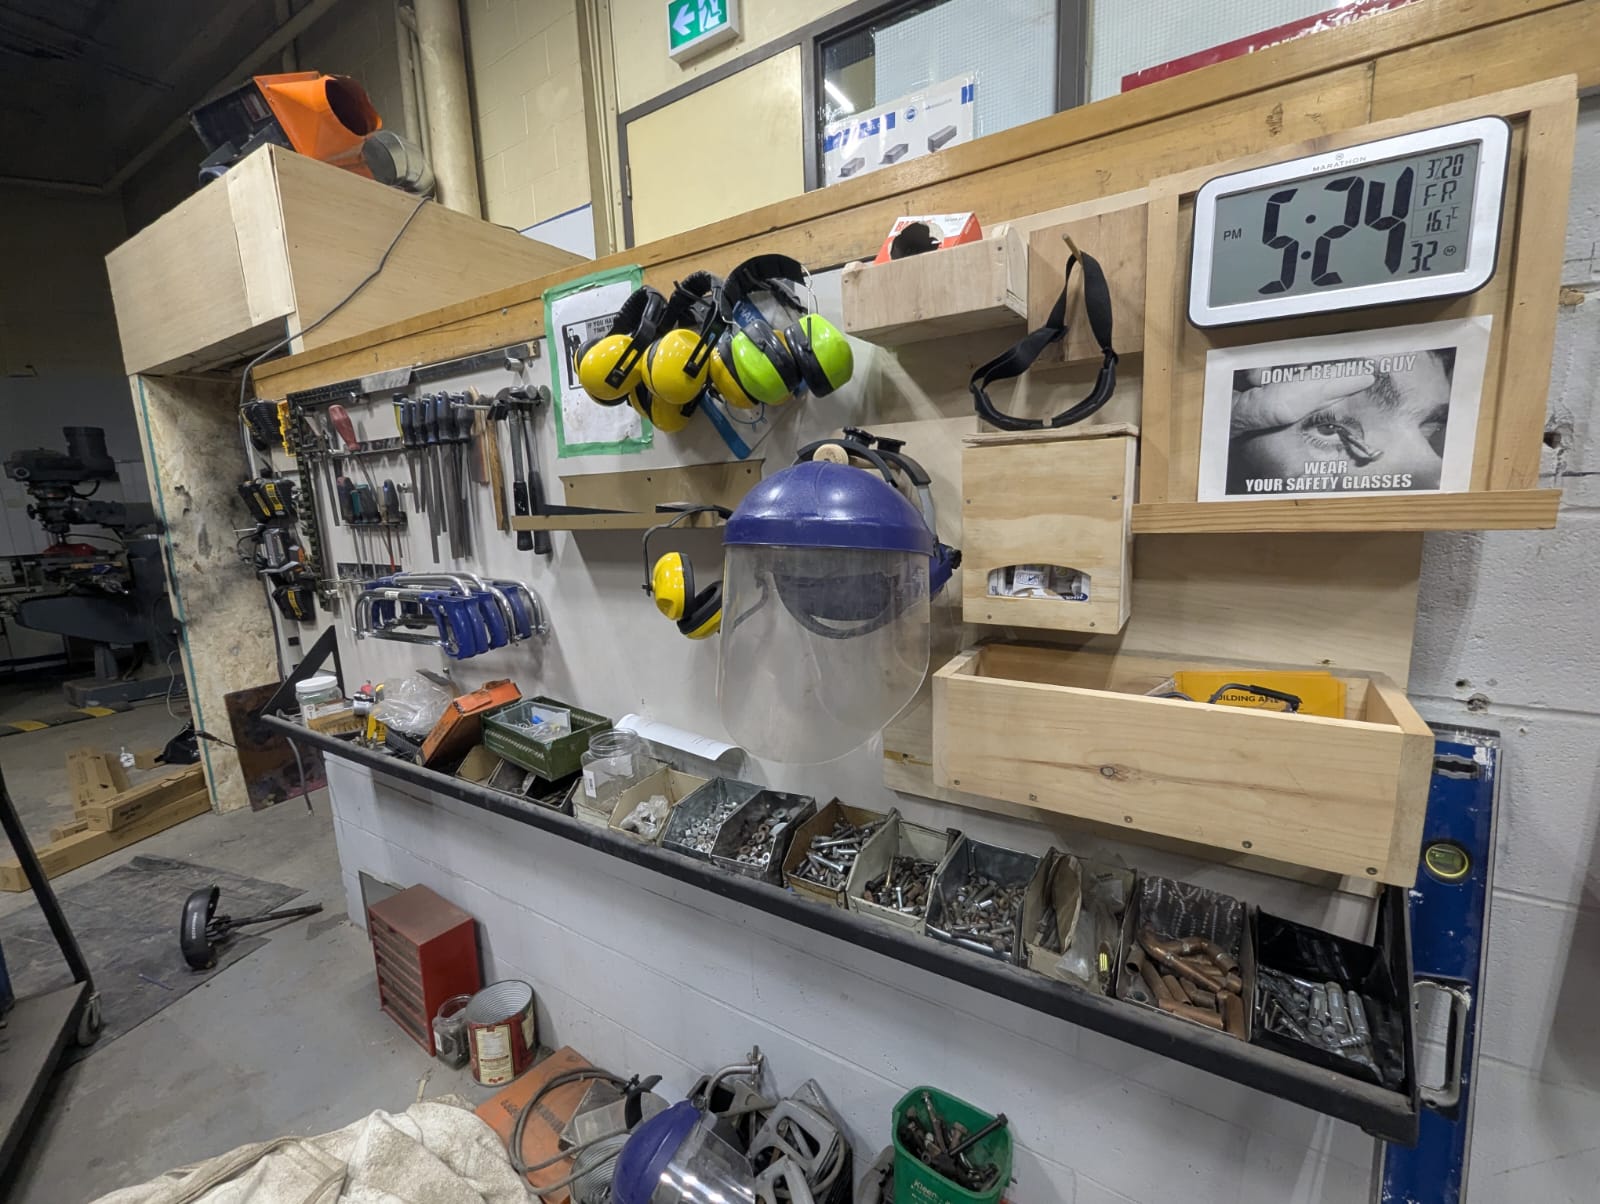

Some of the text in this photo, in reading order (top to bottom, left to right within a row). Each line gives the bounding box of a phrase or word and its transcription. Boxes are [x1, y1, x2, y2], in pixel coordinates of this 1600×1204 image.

[1312, 156, 1367, 172] MARATHON
[1423, 180, 1457, 206] FR
[1223, 228, 1242, 241] PM
[1258, 166, 1414, 295] 5:24
[1408, 241, 1438, 274] 32
[1260, 355, 1417, 385] DON'T BE THIS GUY
[1304, 460, 1348, 475] WEAR
[1245, 473, 1412, 492] YOUR SAFETY GLASSES
